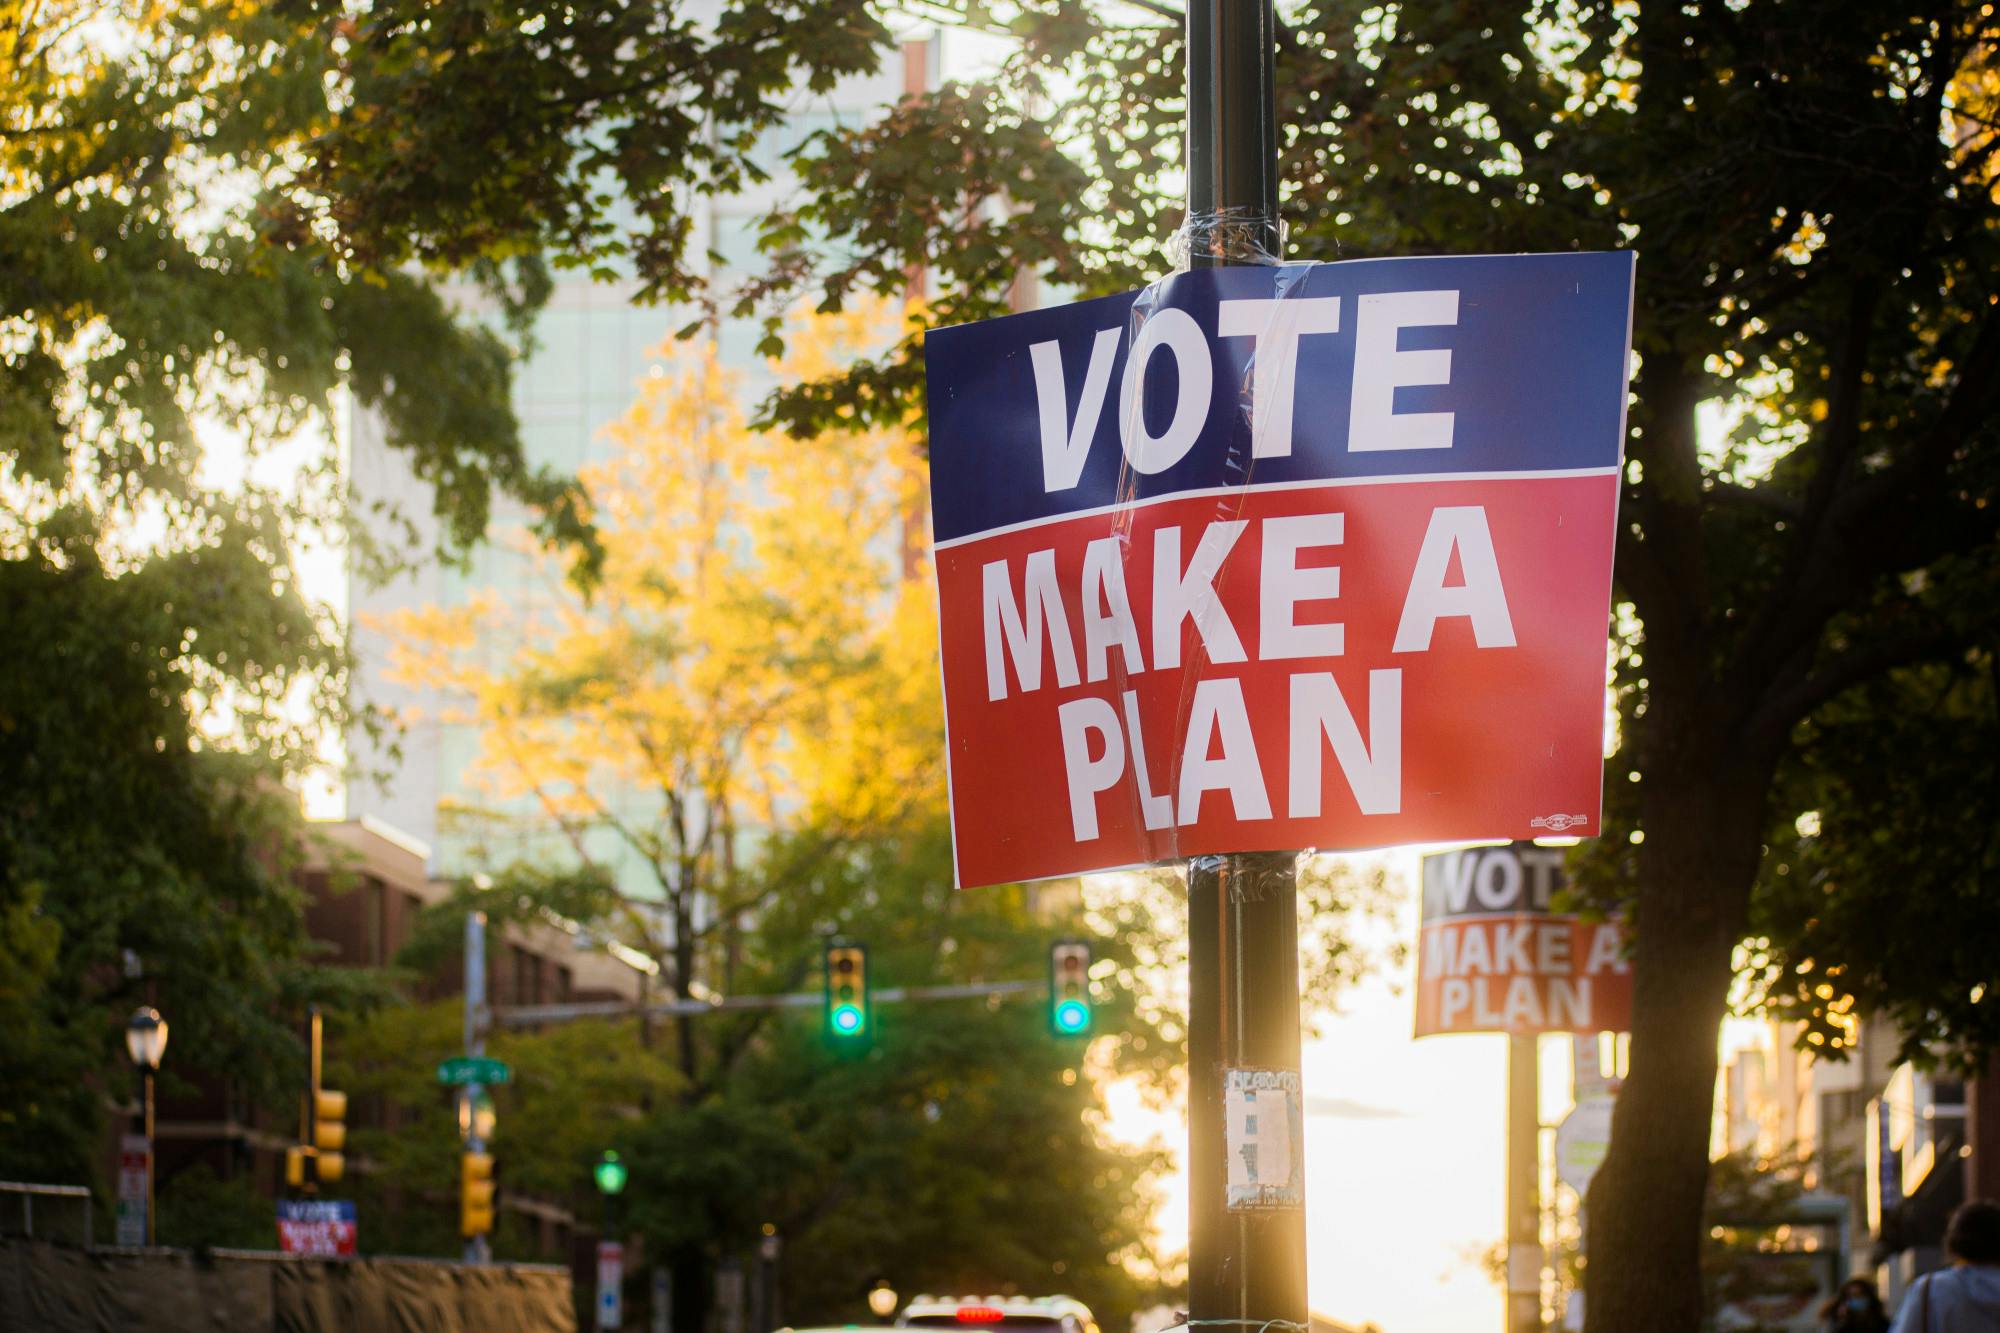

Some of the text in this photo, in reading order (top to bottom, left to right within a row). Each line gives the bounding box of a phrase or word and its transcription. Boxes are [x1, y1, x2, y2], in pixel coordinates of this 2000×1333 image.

[1029, 290, 1460, 493] VOTE
[982, 505, 1518, 702] MAKE A
[1058, 668, 1402, 842] PLAN
[1442, 849, 1566, 913] VOT
[1439, 975, 1594, 1029] PLAN
[1585, 921, 1630, 976] A
